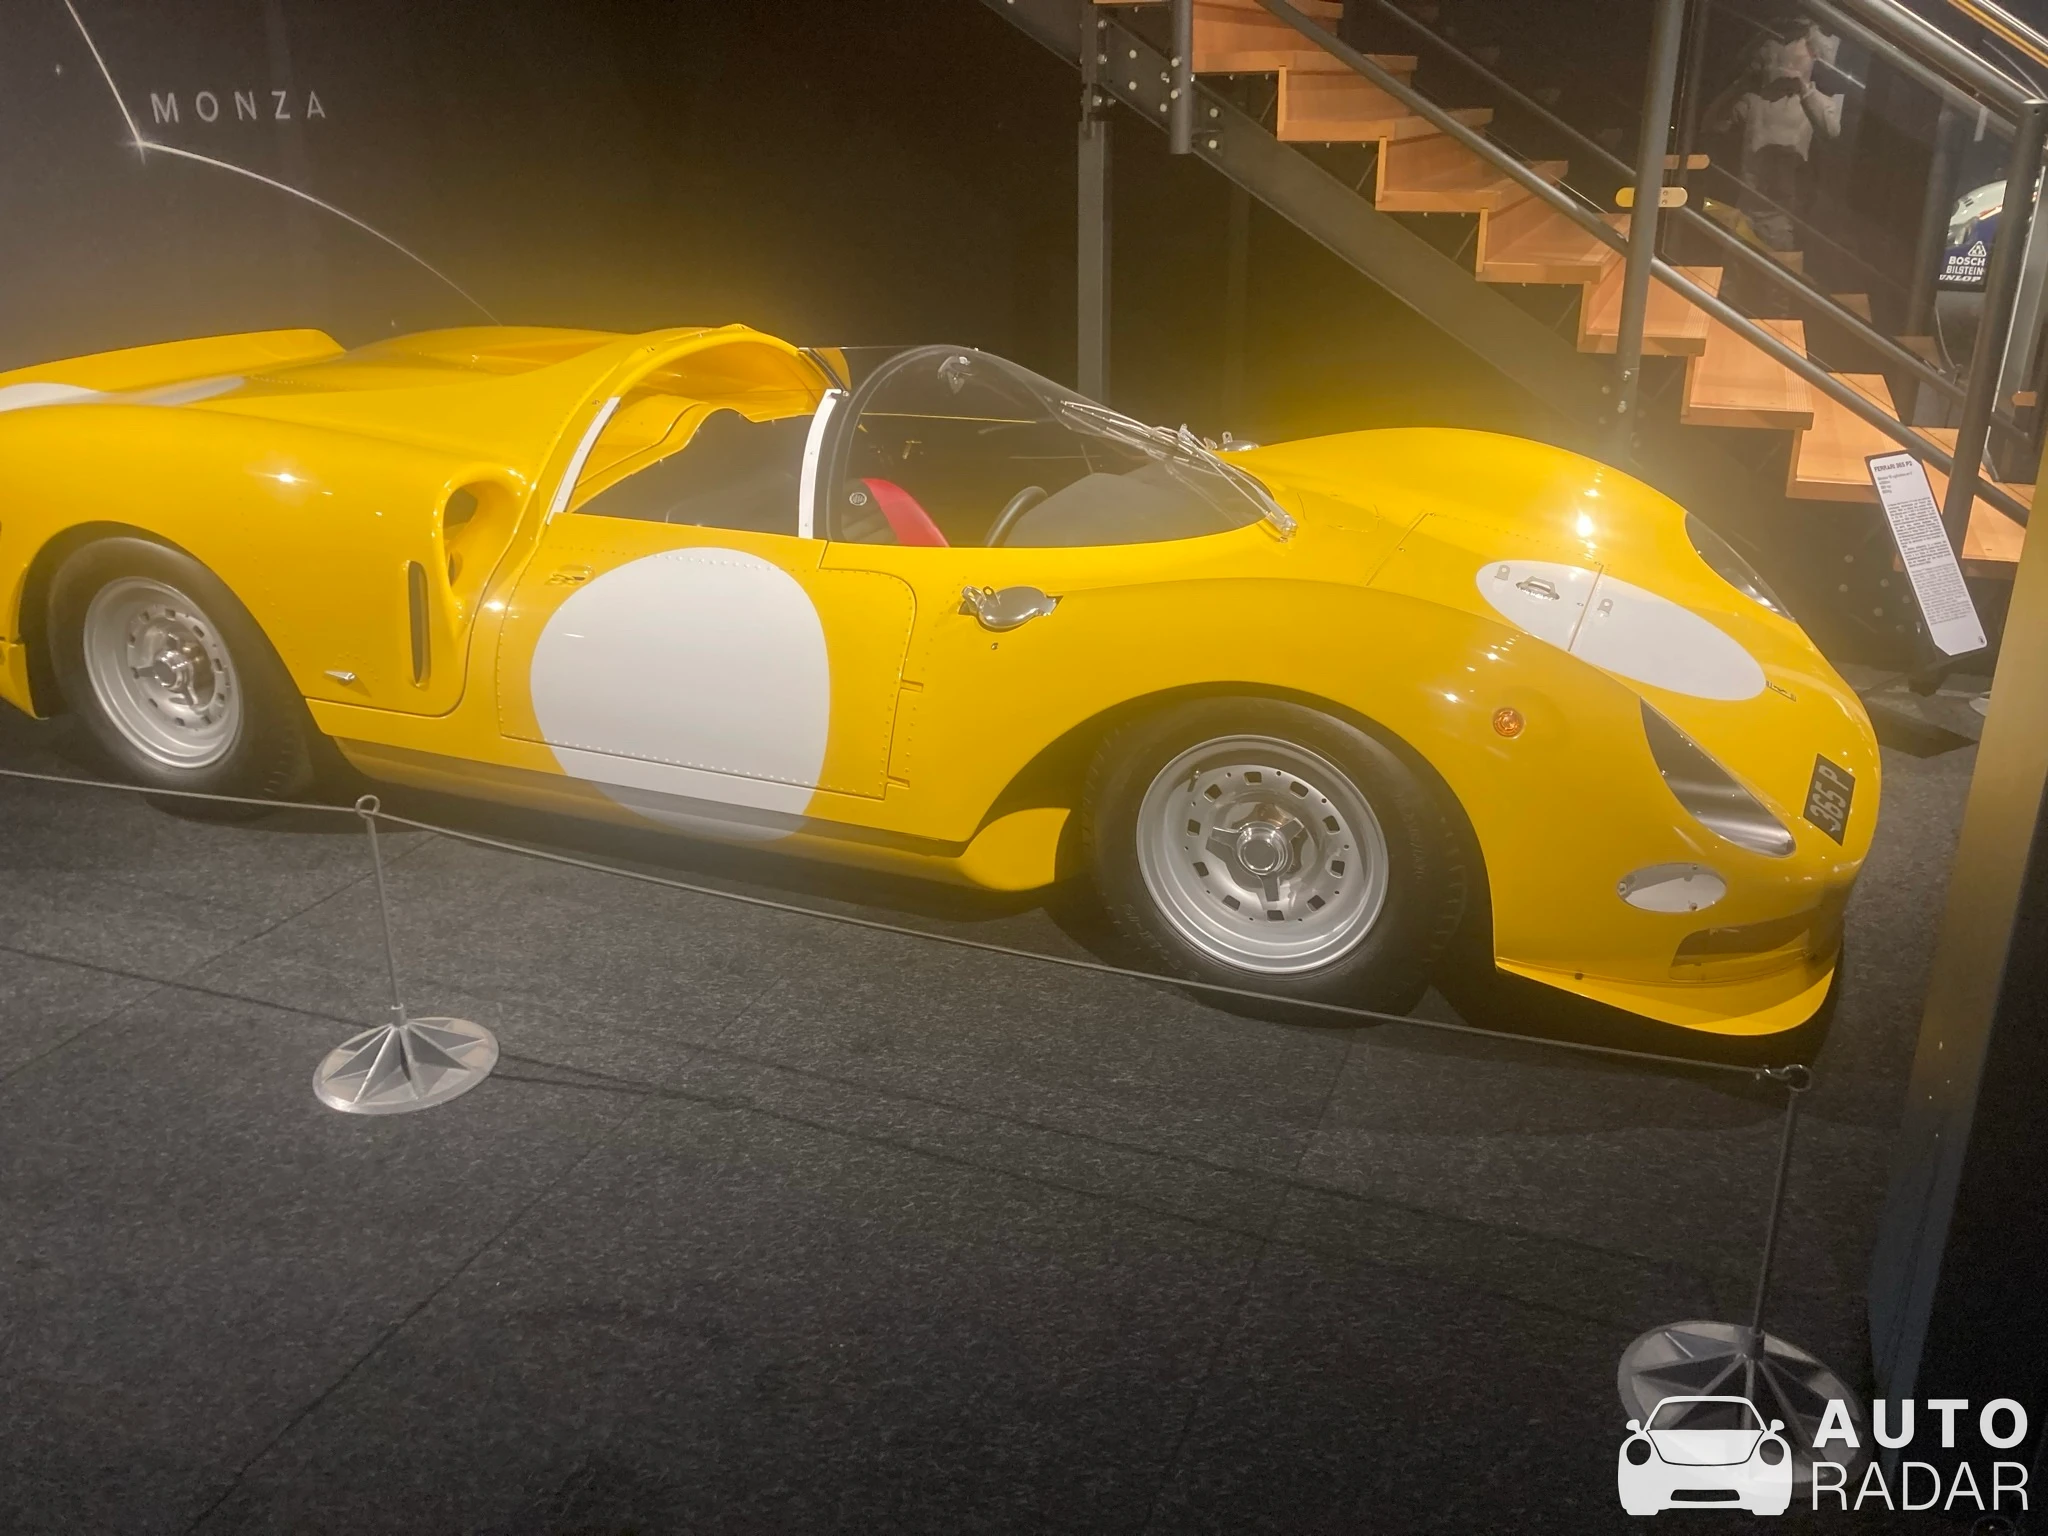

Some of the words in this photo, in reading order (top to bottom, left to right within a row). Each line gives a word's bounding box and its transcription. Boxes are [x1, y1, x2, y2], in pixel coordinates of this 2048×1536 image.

[150, 90, 326, 124] MONZA
[1948, 255, 1986, 266] BOSCH
[1946, 265, 1984, 275] BILSTEIN
[1874, 464, 1896, 472] FERRARI
[1818, 765, 1849, 791] P
[1809, 780, 1846, 832] 365
